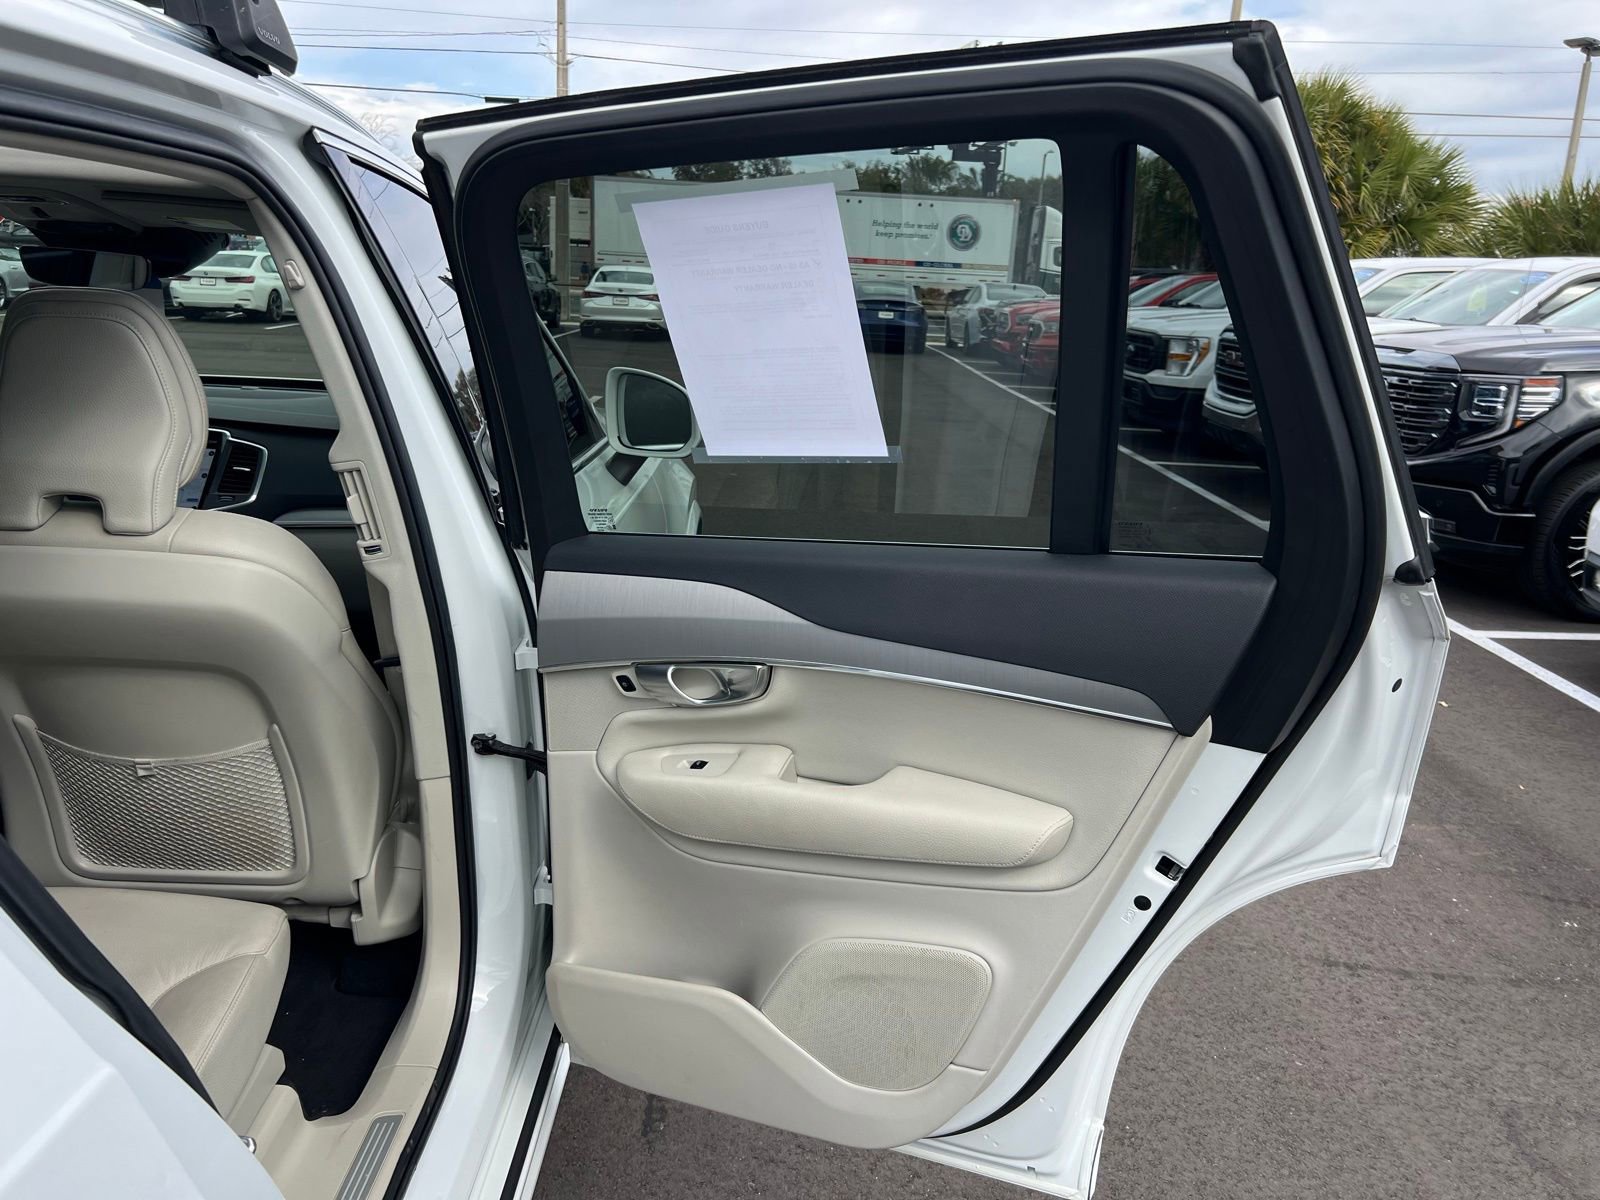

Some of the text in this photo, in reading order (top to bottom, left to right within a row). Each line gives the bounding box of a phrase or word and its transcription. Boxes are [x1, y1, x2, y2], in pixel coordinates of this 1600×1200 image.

[872, 219, 939, 230] Helping the world
[875, 230, 893, 239] keep
